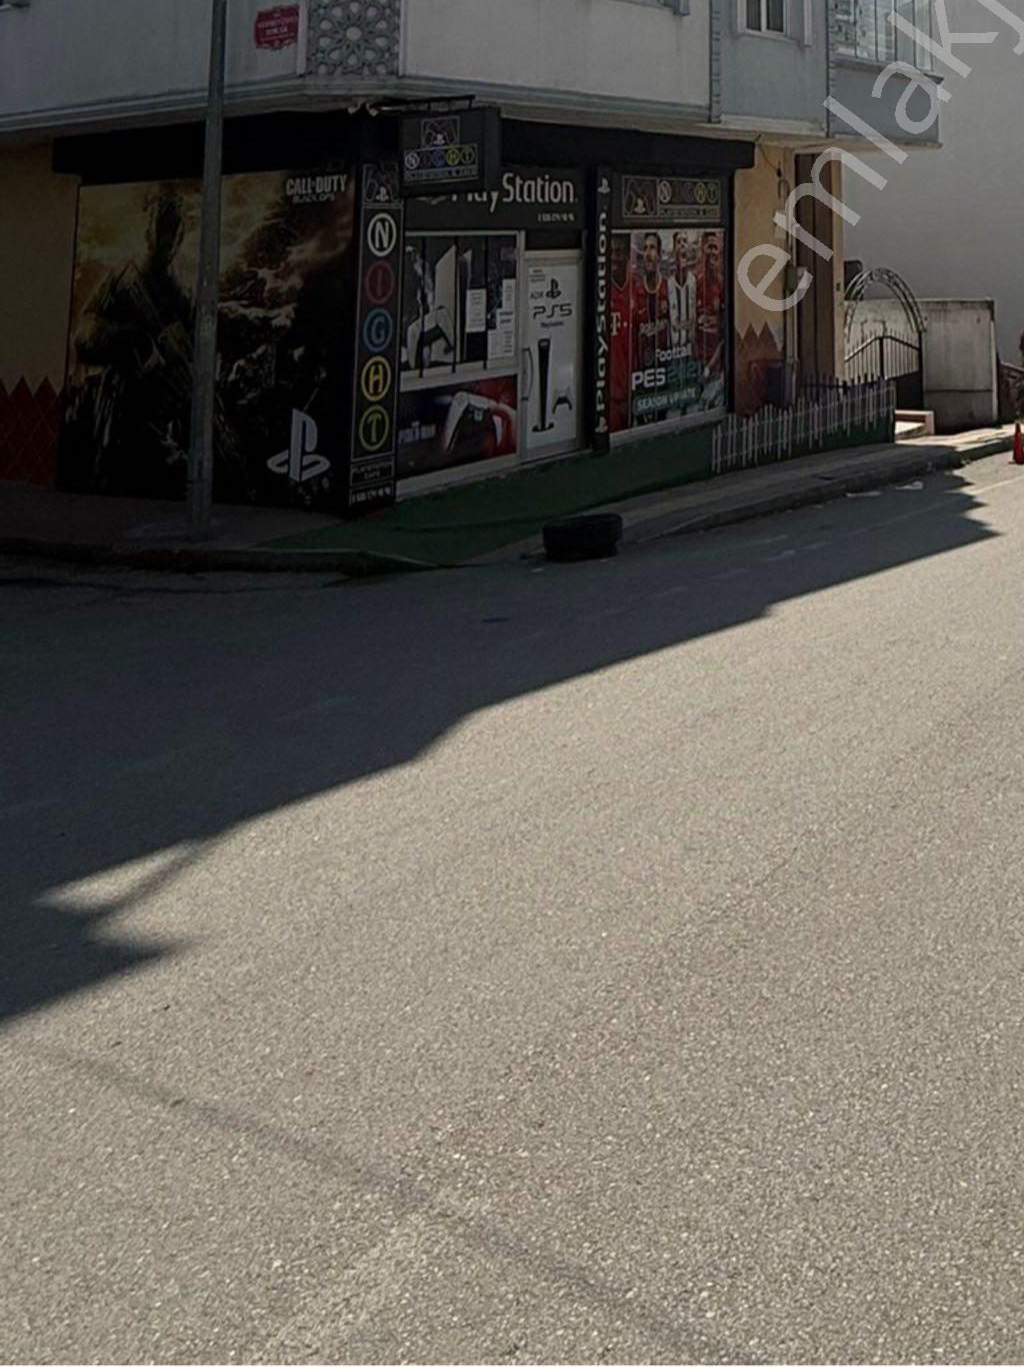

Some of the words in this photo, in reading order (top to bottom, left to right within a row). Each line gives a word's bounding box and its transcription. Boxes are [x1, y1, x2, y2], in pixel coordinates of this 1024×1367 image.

[286, 177, 312, 196] CALL
[315, 174, 347, 194] DUTY
[451, 172, 575, 213] yStation
[533, 303, 572, 320] PS5
[596, 211, 608, 411] PlayStation
[632, 367, 666, 391] PES
